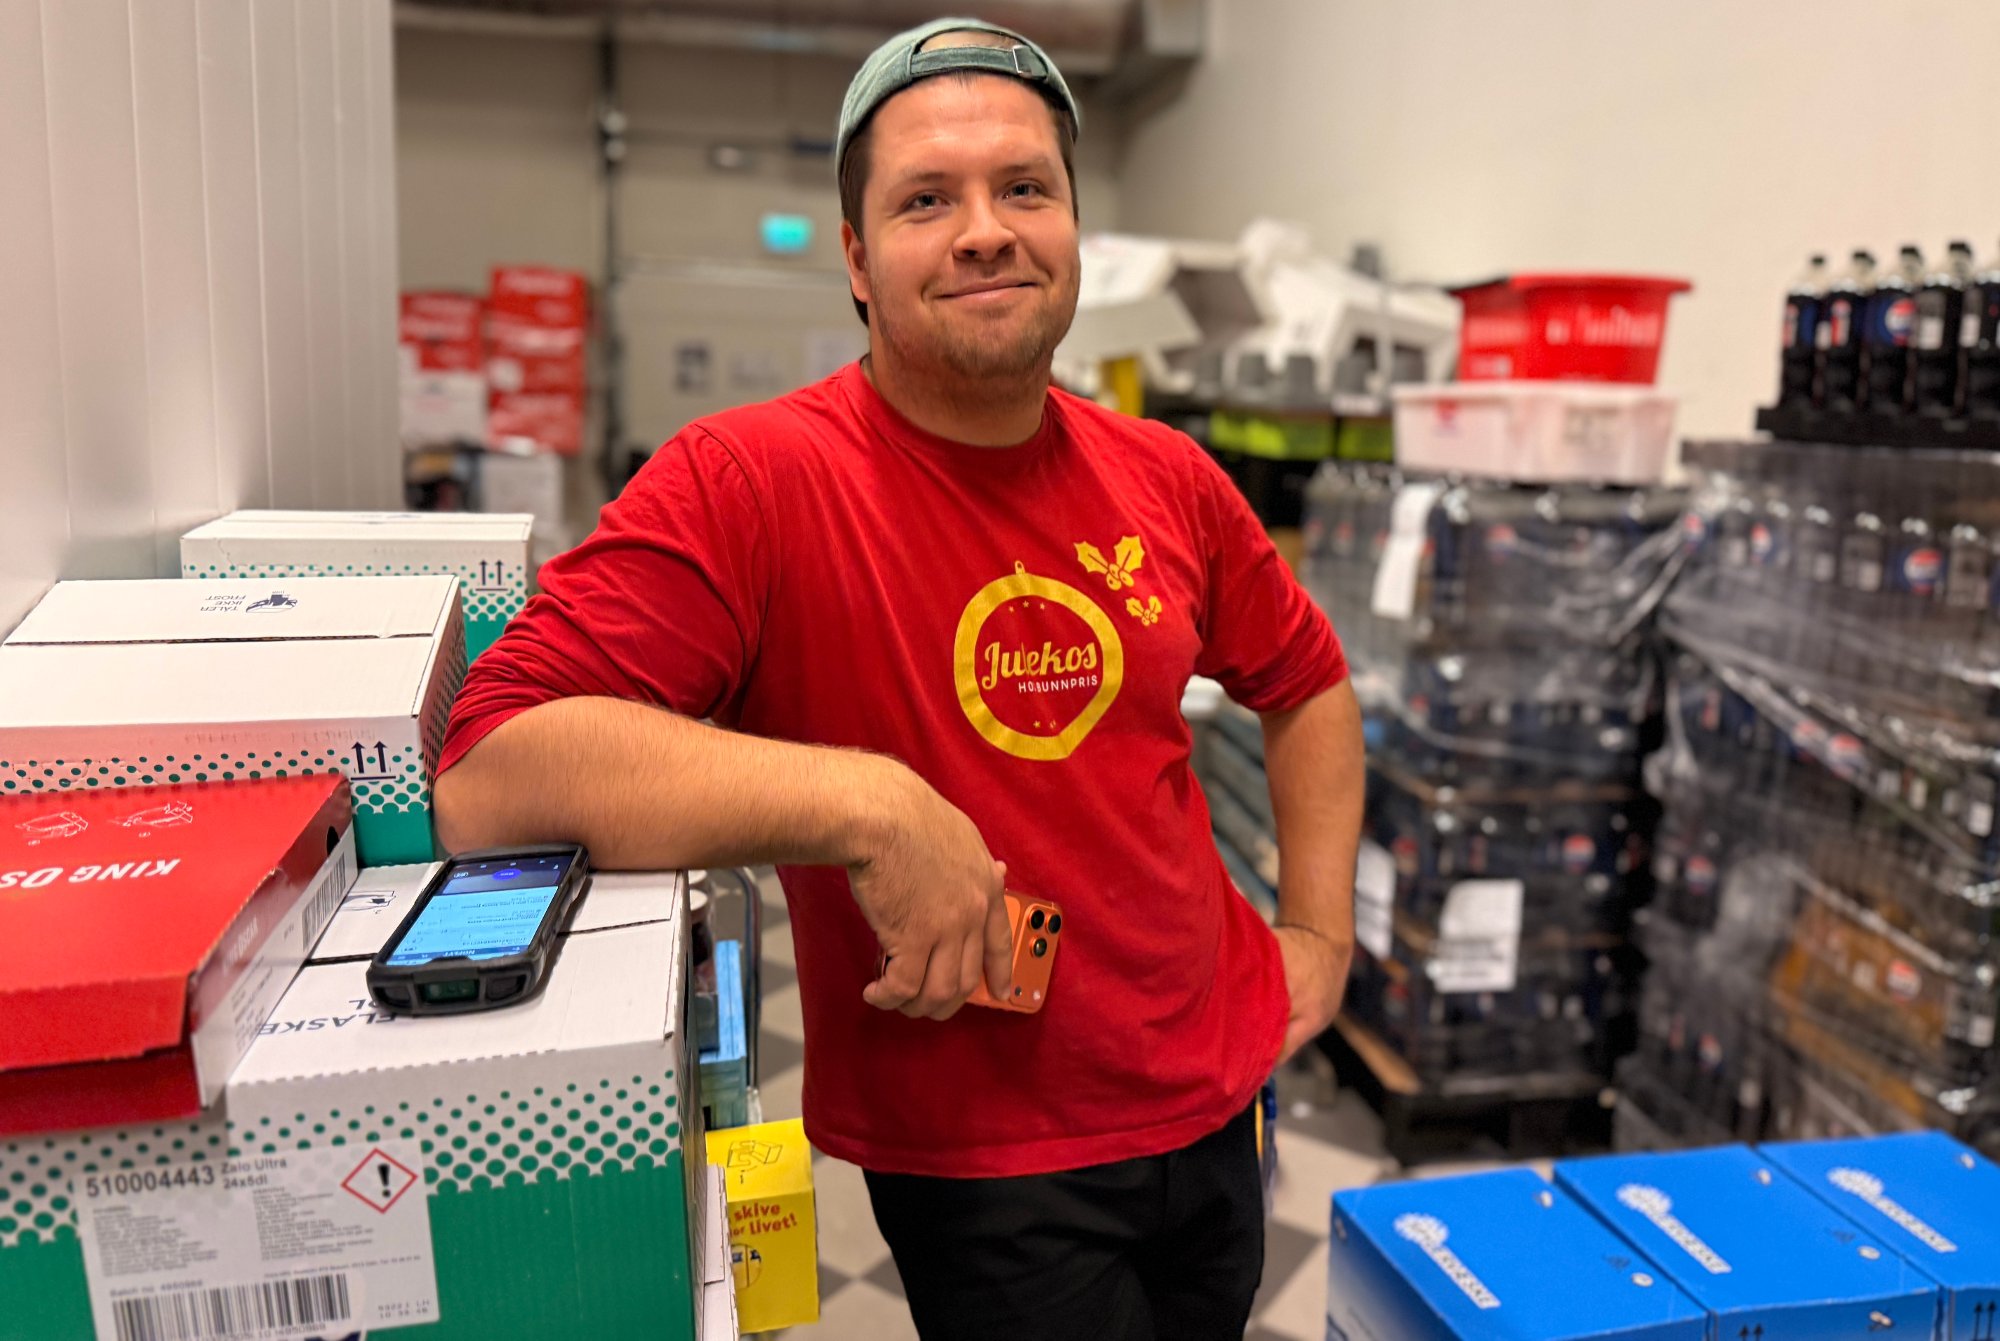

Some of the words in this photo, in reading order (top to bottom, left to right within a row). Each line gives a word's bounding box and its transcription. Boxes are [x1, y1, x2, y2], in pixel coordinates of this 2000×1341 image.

[981, 641, 1098, 690] Juekos
[68, 859, 181, 883] KING
[86, 1164, 216, 1197] 510004443
[221, 1160, 251, 1175] Zalo
[254, 1158, 287, 1171] Ultra
[223, 1174, 268, 1190] 24x5dl
[734, 1201, 780, 1221] skive
